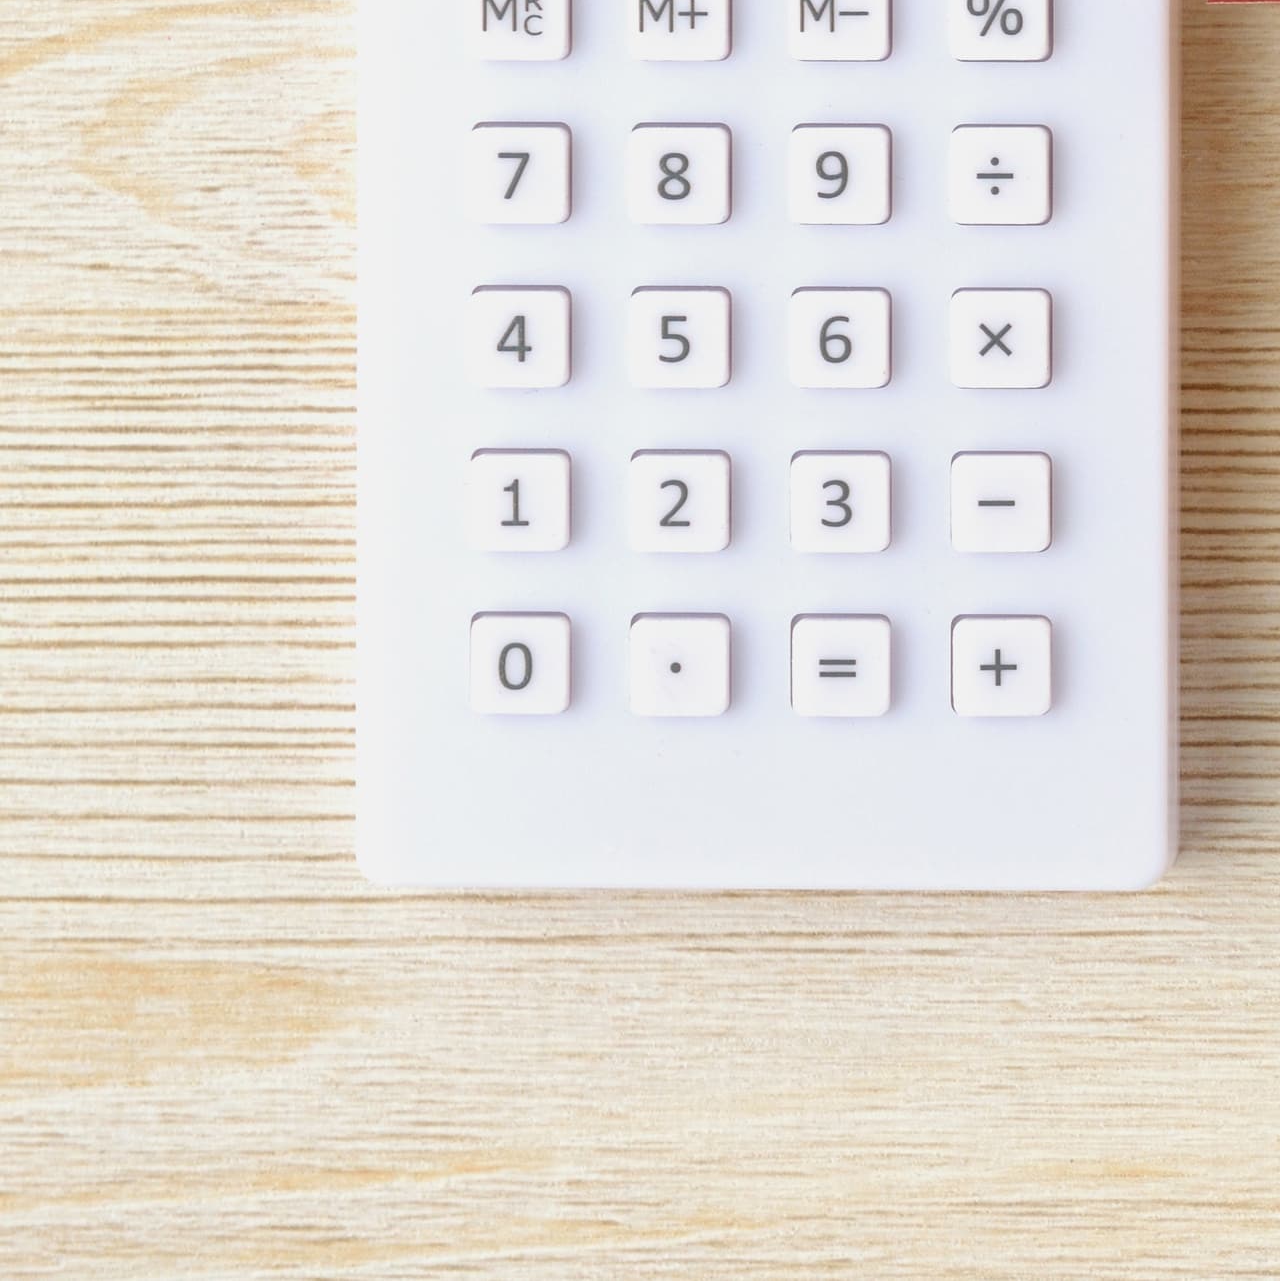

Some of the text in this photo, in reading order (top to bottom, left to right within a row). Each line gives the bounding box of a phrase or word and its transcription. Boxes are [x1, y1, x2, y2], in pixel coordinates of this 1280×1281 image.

[497, 151, 531, 200] 7
[656, 151, 692, 201] 8
[815, 150, 850, 200] 9
[496, 314, 533, 363] 4
[658, 314, 692, 364] 5
[818, 314, 853, 365] 6
[500, 478, 531, 527] 1
[658, 478, 692, 528] 2
[820, 478, 854, 529] 3
[497, 641, 534, 691] 0
